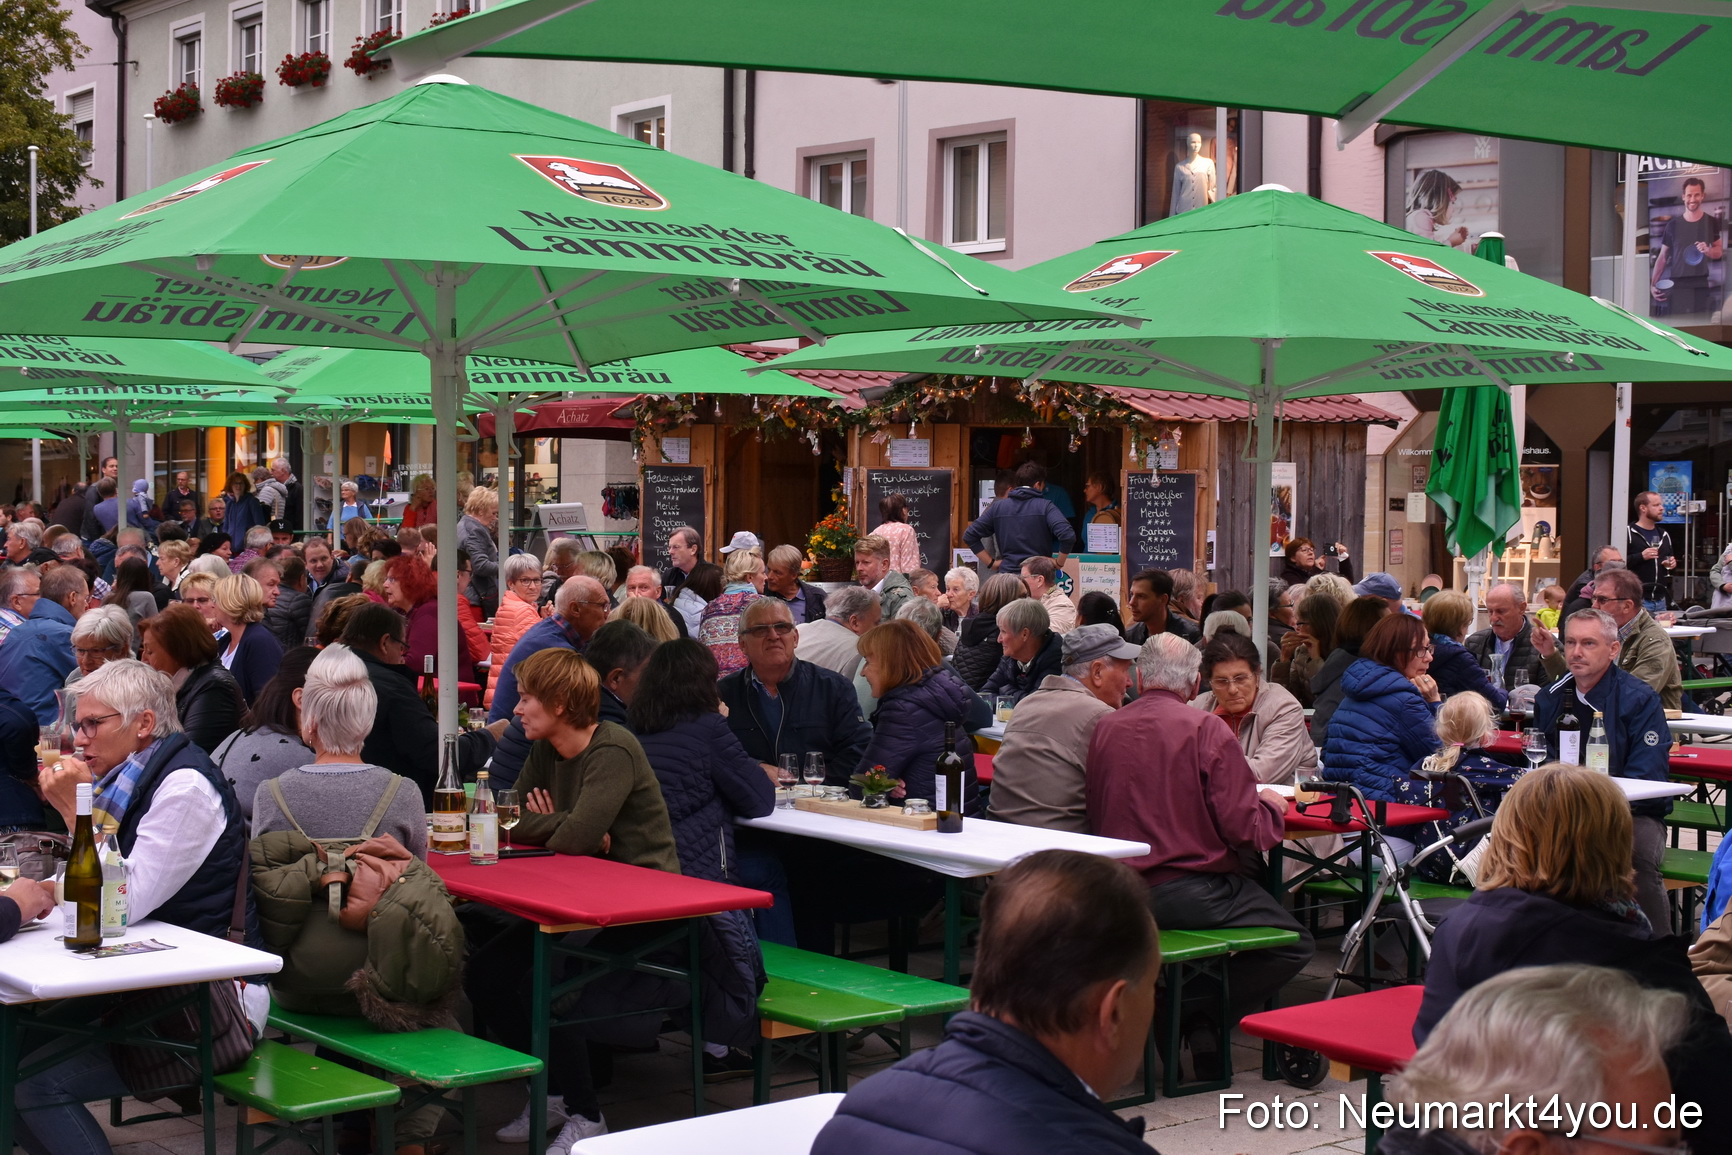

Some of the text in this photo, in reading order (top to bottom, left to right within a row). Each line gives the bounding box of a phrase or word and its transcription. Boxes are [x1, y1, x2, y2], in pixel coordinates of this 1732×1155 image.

[601, 195, 650, 206] 1628
[519, 210, 796, 248] Neumarkter
[487, 226, 887, 279] Lammsbräu
[1407, 298, 1580, 327] Neumarkter
[1403, 312, 1651, 352] Lammsbräu
[467, 368, 673, 384] ammsbräu
[337, 394, 431, 405] msbräu
[556, 409, 590, 424] Achatz
[1397, 447, 1552, 456] Willkomm ishaus.
[870, 472, 934, 484] Fränkischer
[1128, 475, 1179, 485] Fräncher
[1128, 487, 1184, 500] Federweißer
[656, 501, 681, 511] Merlot
[548, 512, 580, 525] Achatz
[1140, 508, 1170, 518] Merlot
[652, 517, 687, 527] Barbera
[1138, 525, 1176, 537] Barbera
[1138, 541, 1179, 560] Riesling
